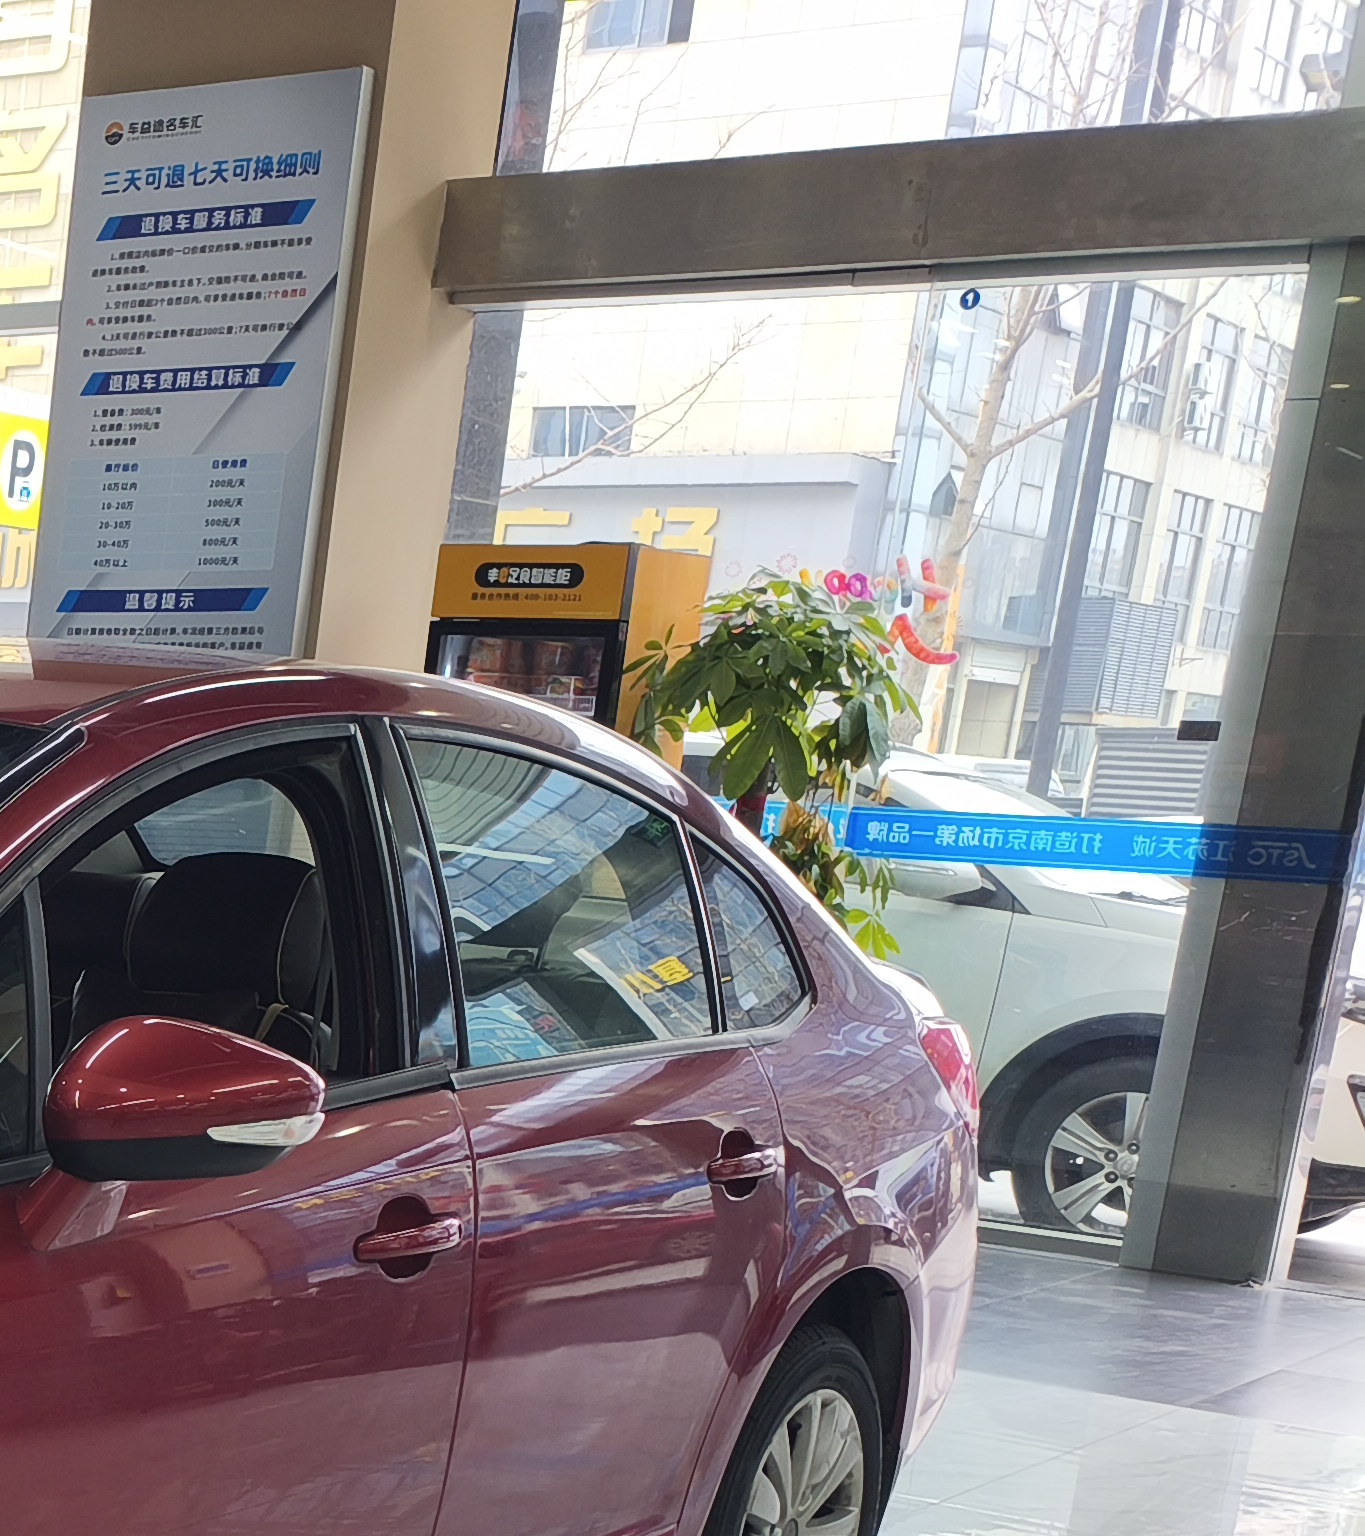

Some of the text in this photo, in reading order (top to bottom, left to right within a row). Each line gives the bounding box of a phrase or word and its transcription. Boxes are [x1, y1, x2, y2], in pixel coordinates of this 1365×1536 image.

[101, 149, 322, 195] 三天可退七天可换细则
[140, 206, 265, 234] 退换车服务标准
[965, 292, 974, 307] 1
[108, 367, 262, 392] 退换车费用结算标准
[9, 438, 36, 499] P
[101, 500, 134, 511] 10-20万
[204, 517, 241, 528] 500元/天
[198, 556, 239, 567] 1000元/天
[125, 593, 195, 610] 温馨提示
